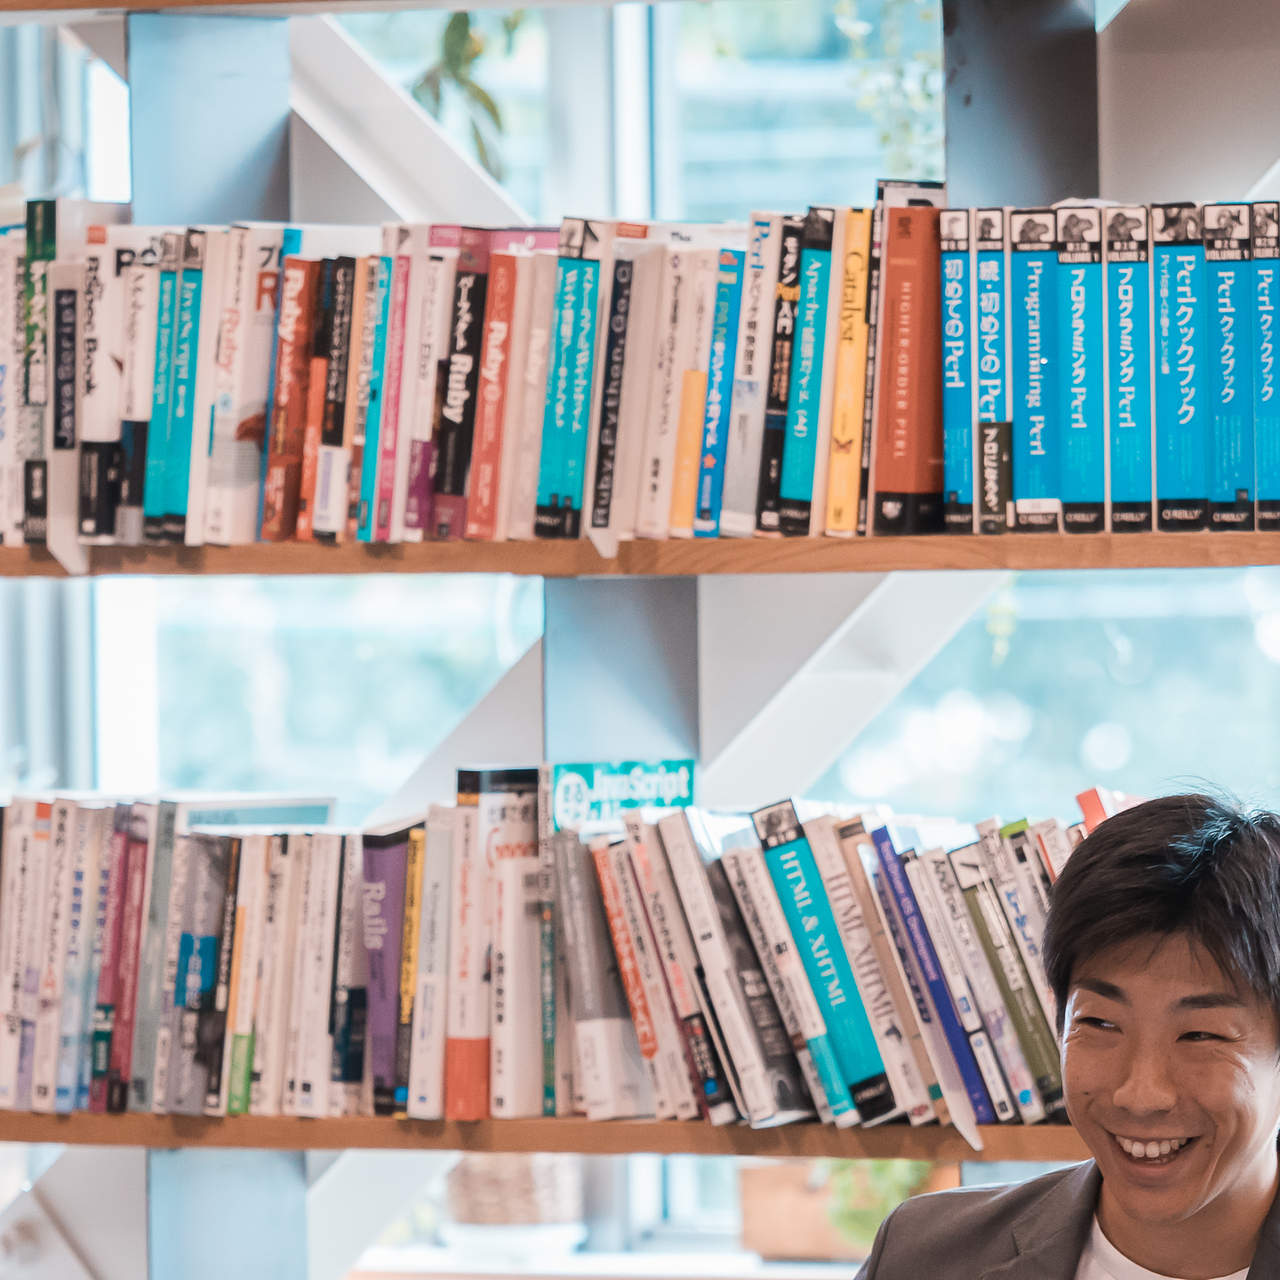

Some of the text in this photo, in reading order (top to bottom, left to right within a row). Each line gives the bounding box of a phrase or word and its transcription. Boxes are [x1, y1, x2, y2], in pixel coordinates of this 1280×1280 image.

[174, 281, 197, 380] JavaScript
[277, 268, 306, 343] Ruby
[482, 322, 509, 384] Ruby
[840, 251, 866, 342] Catalyst
[944, 258, 966, 388] 初めてのPerl
[979, 260, 1001, 422] 続・初めてのPer
[1025, 260, 1043, 408] Programming
[1070, 268, 1087, 429] プログラミングPerl
[1118, 267, 1137, 428] プログラミングPerl
[1176, 255, 1197, 426] Perlクックブック
[1217, 271, 1235, 404] Perlクックブック
[1257, 270, 1274, 402] Perlクックブック
[57, 292, 75, 447] JavaScript
[82, 337, 97, 396] Book
[443, 354, 472, 424] Ruby
[894, 282, 913, 458] HIGHER-ORDER PERL
[1028, 415, 1046, 455] Perl
[589, 764, 690, 806] JavaScript
[362, 881, 389, 950] Rails
[780, 850, 846, 1011] HTML & XHTML
[826, 874, 896, 1020] HTML XHTML
